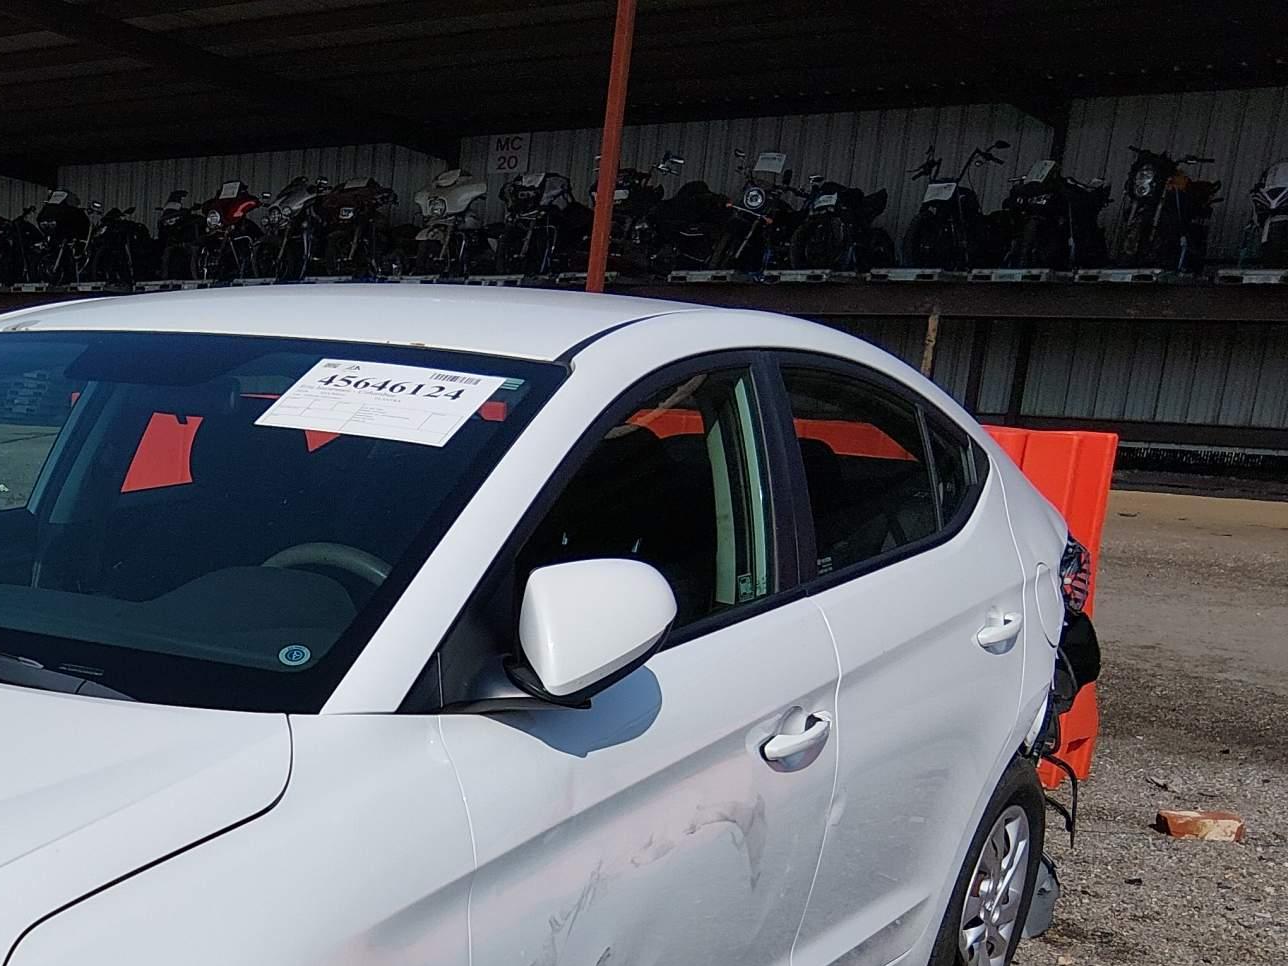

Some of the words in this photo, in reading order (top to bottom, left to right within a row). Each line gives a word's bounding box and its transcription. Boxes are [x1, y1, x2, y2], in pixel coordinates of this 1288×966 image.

[496, 136, 522, 151] MC
[496, 155, 518, 170] 20
[318, 374, 465, 401] 45646124
